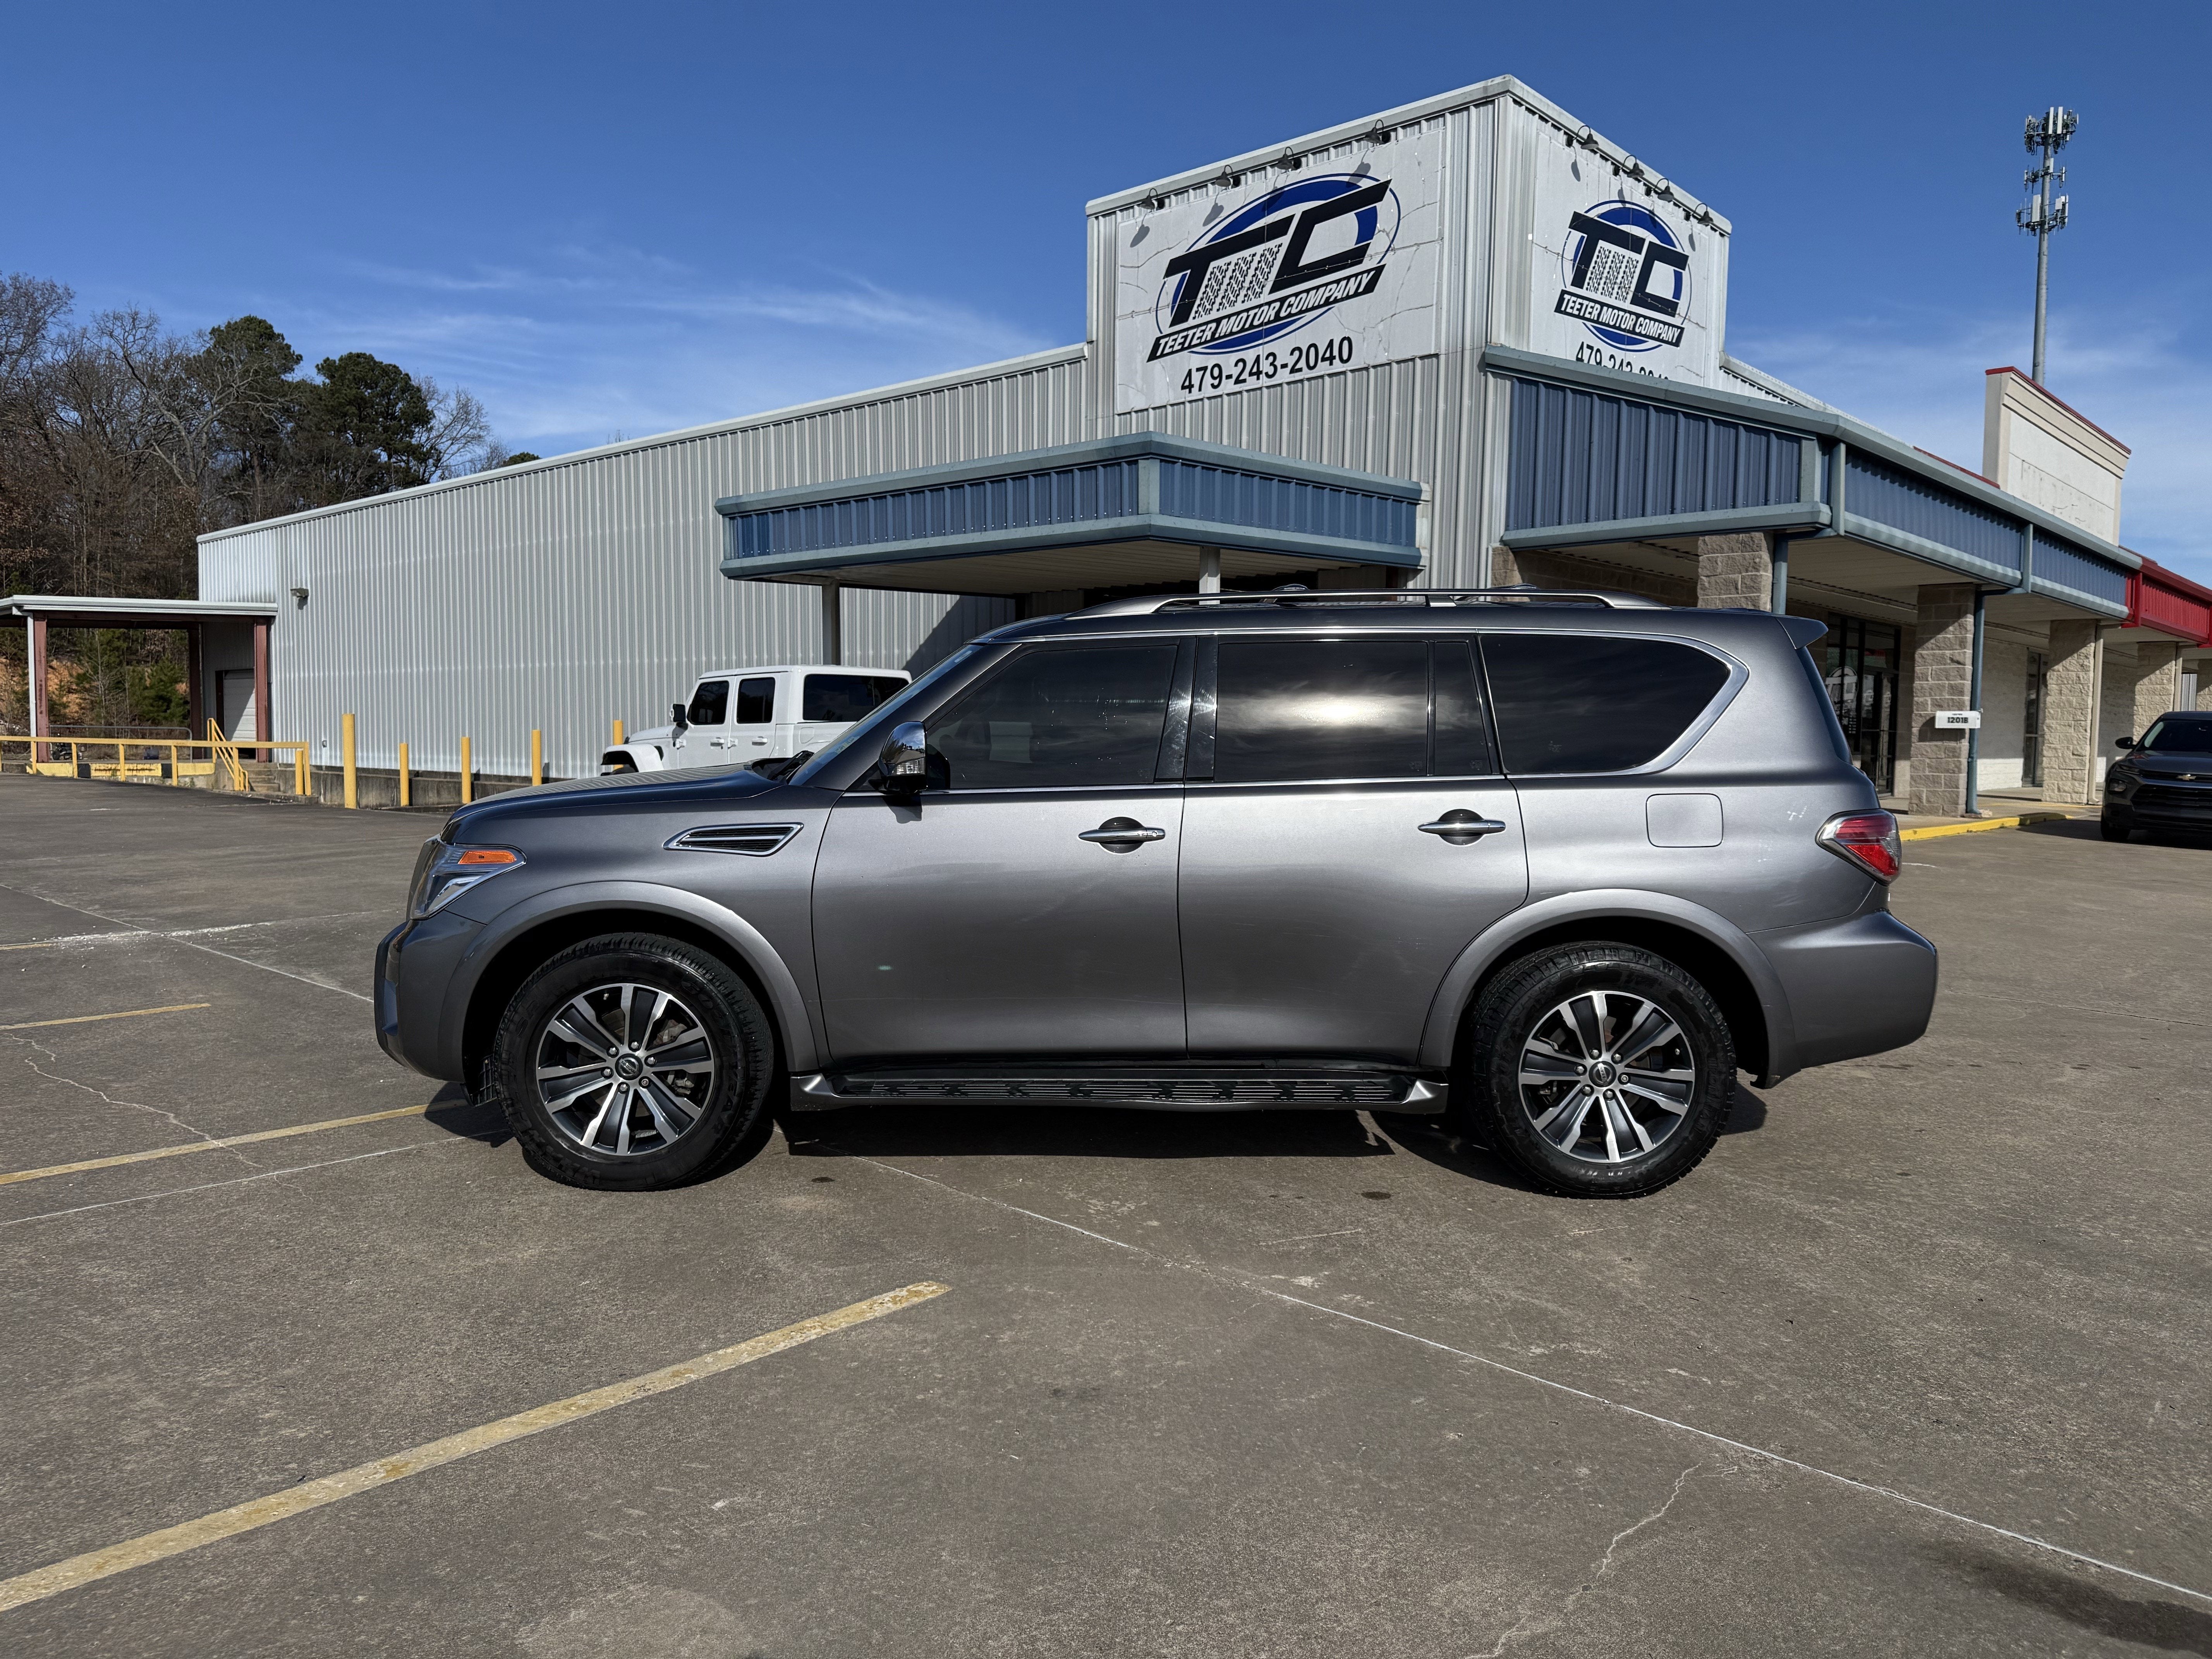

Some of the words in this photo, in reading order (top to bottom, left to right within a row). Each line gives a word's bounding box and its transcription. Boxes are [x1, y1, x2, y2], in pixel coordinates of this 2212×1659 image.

[1156, 325, 1217, 356] TEETER
[1216, 302, 1280, 337] MOTOR
[1279, 271, 1376, 318] COMPANY
[1561, 294, 1601, 321] TEETER
[1599, 306, 1636, 331] MOTOR
[1635, 317, 1681, 343] COMPANY
[1180, 336, 1353, 394] 479-243-2040
